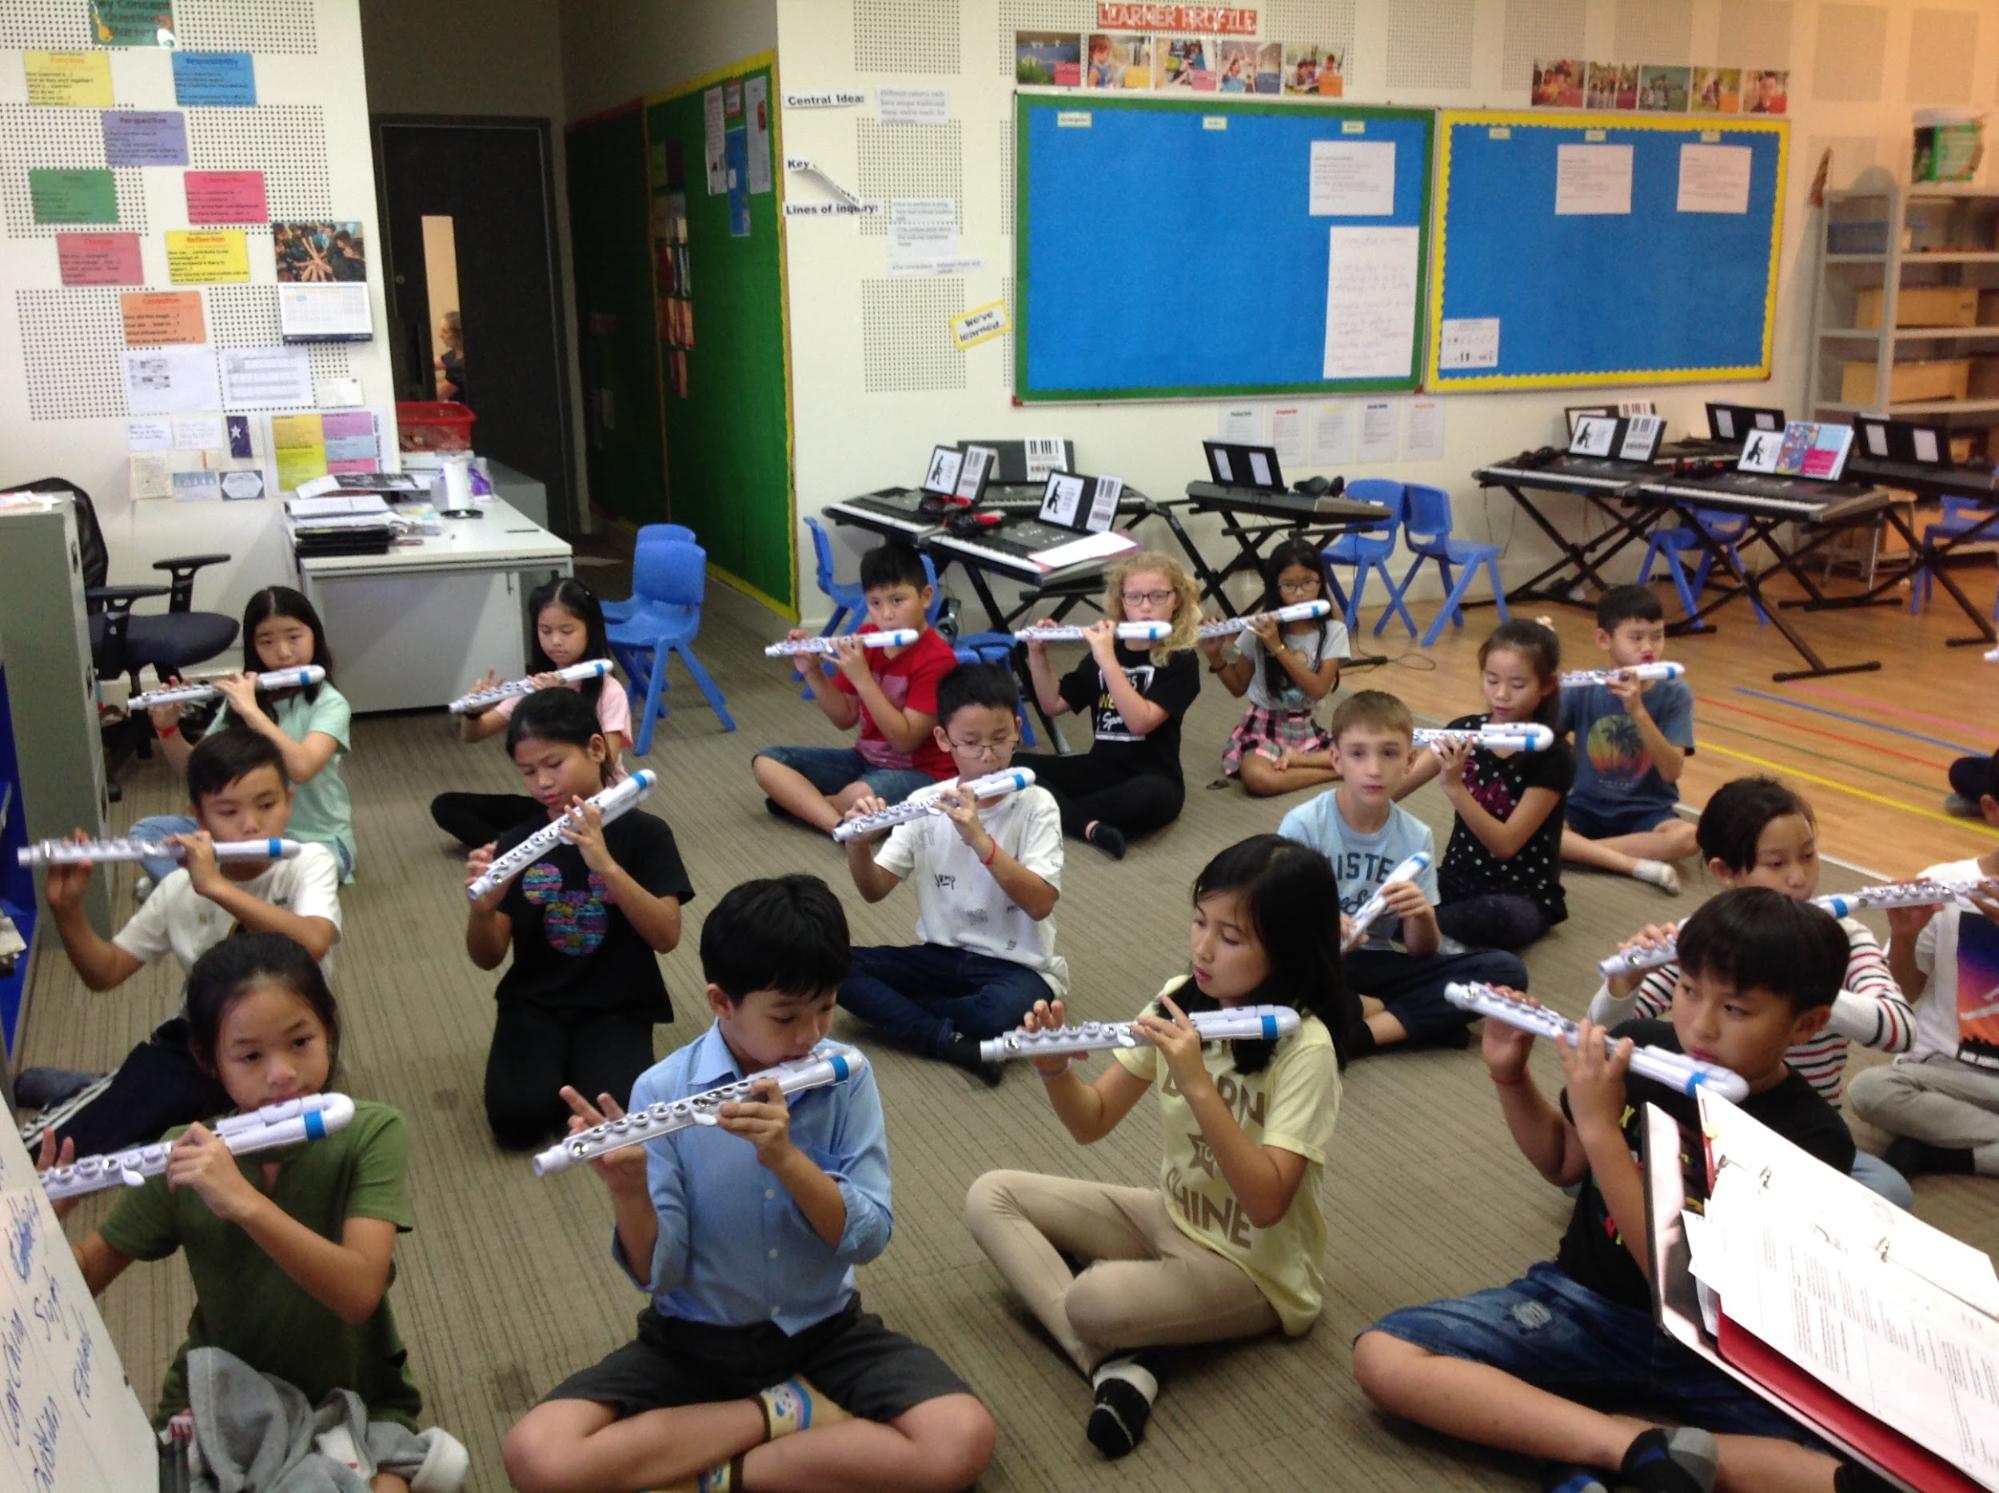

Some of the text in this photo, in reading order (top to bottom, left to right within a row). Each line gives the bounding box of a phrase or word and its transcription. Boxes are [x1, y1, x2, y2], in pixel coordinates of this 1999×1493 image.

[1098, 4, 1256, 32] LEARNER PROFILE
[788, 93, 865, 106] Central Idea:
[787, 159, 810, 170] Key
[786, 204, 879, 216] Lines of inqury:
[1337, 852, 1395, 884] ISTE
[1166, 1166, 1252, 1250] SHINE
